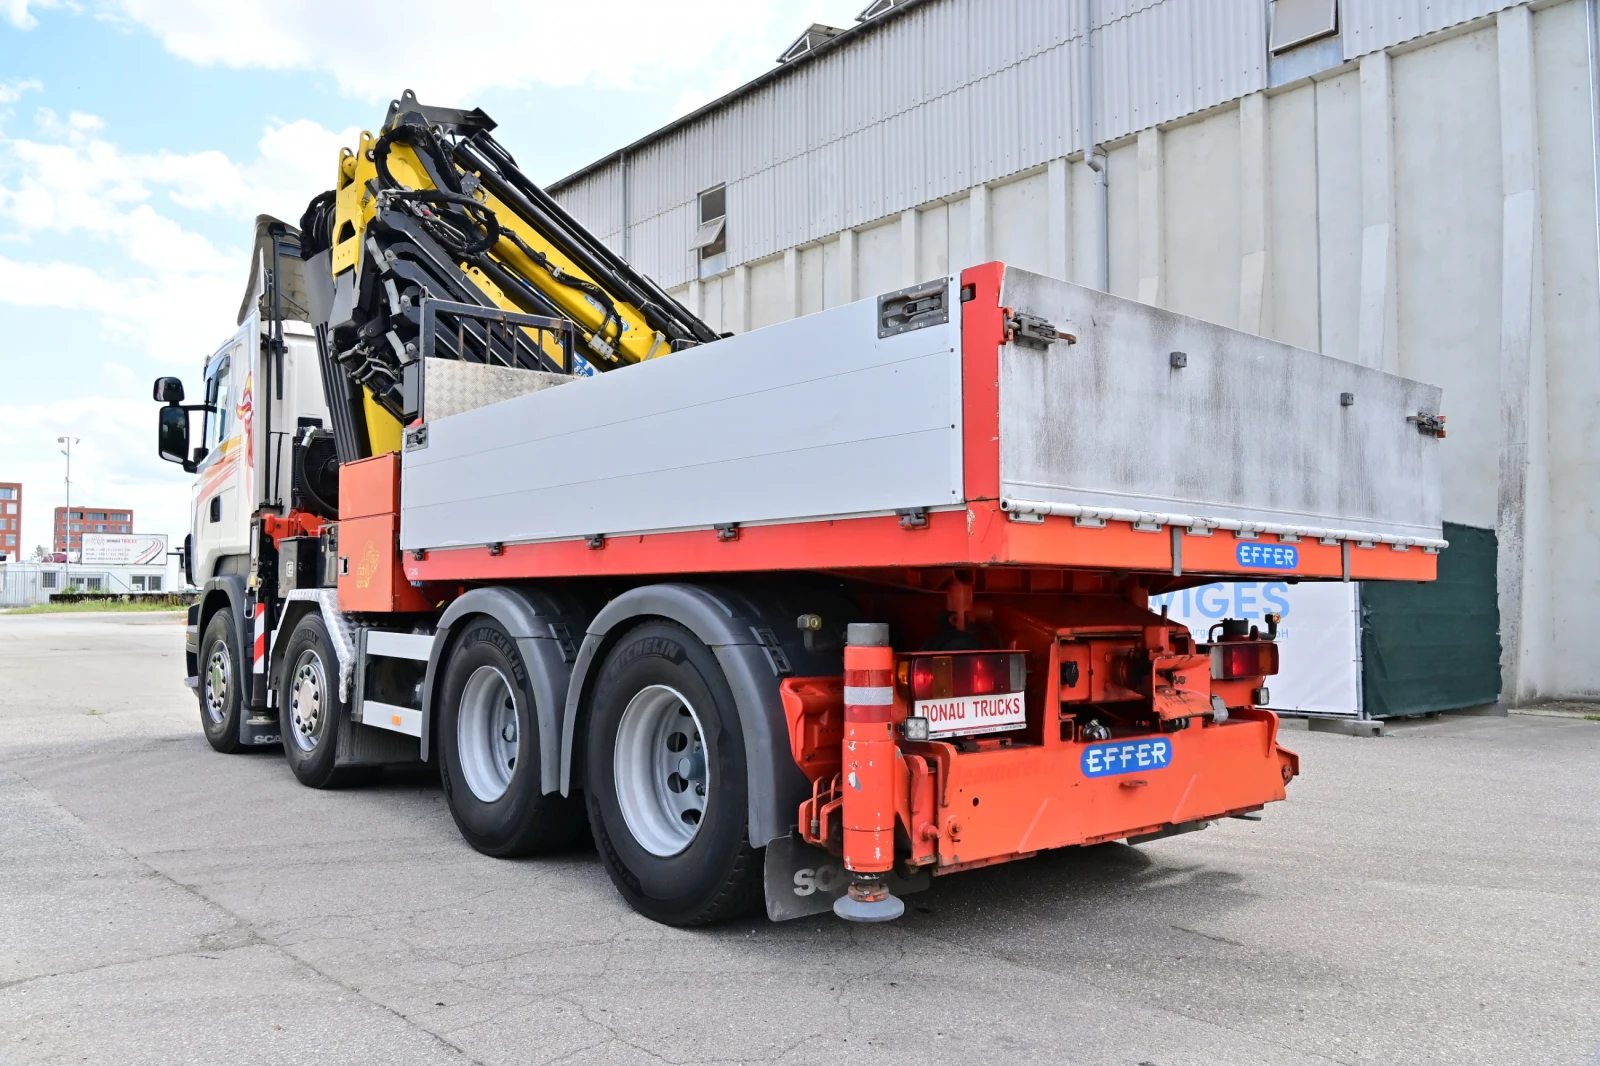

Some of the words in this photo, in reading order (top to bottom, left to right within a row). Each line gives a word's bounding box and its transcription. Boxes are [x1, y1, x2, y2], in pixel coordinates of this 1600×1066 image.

[1239, 545, 1294, 566] EFFER
[478, 628, 525, 681] MICHELIN
[609, 638, 680, 679] MICHELIN
[921, 701, 965, 722] DONAU
[972, 697, 1020, 718] TRUCKS
[1085, 742, 1166, 773] EFFER
